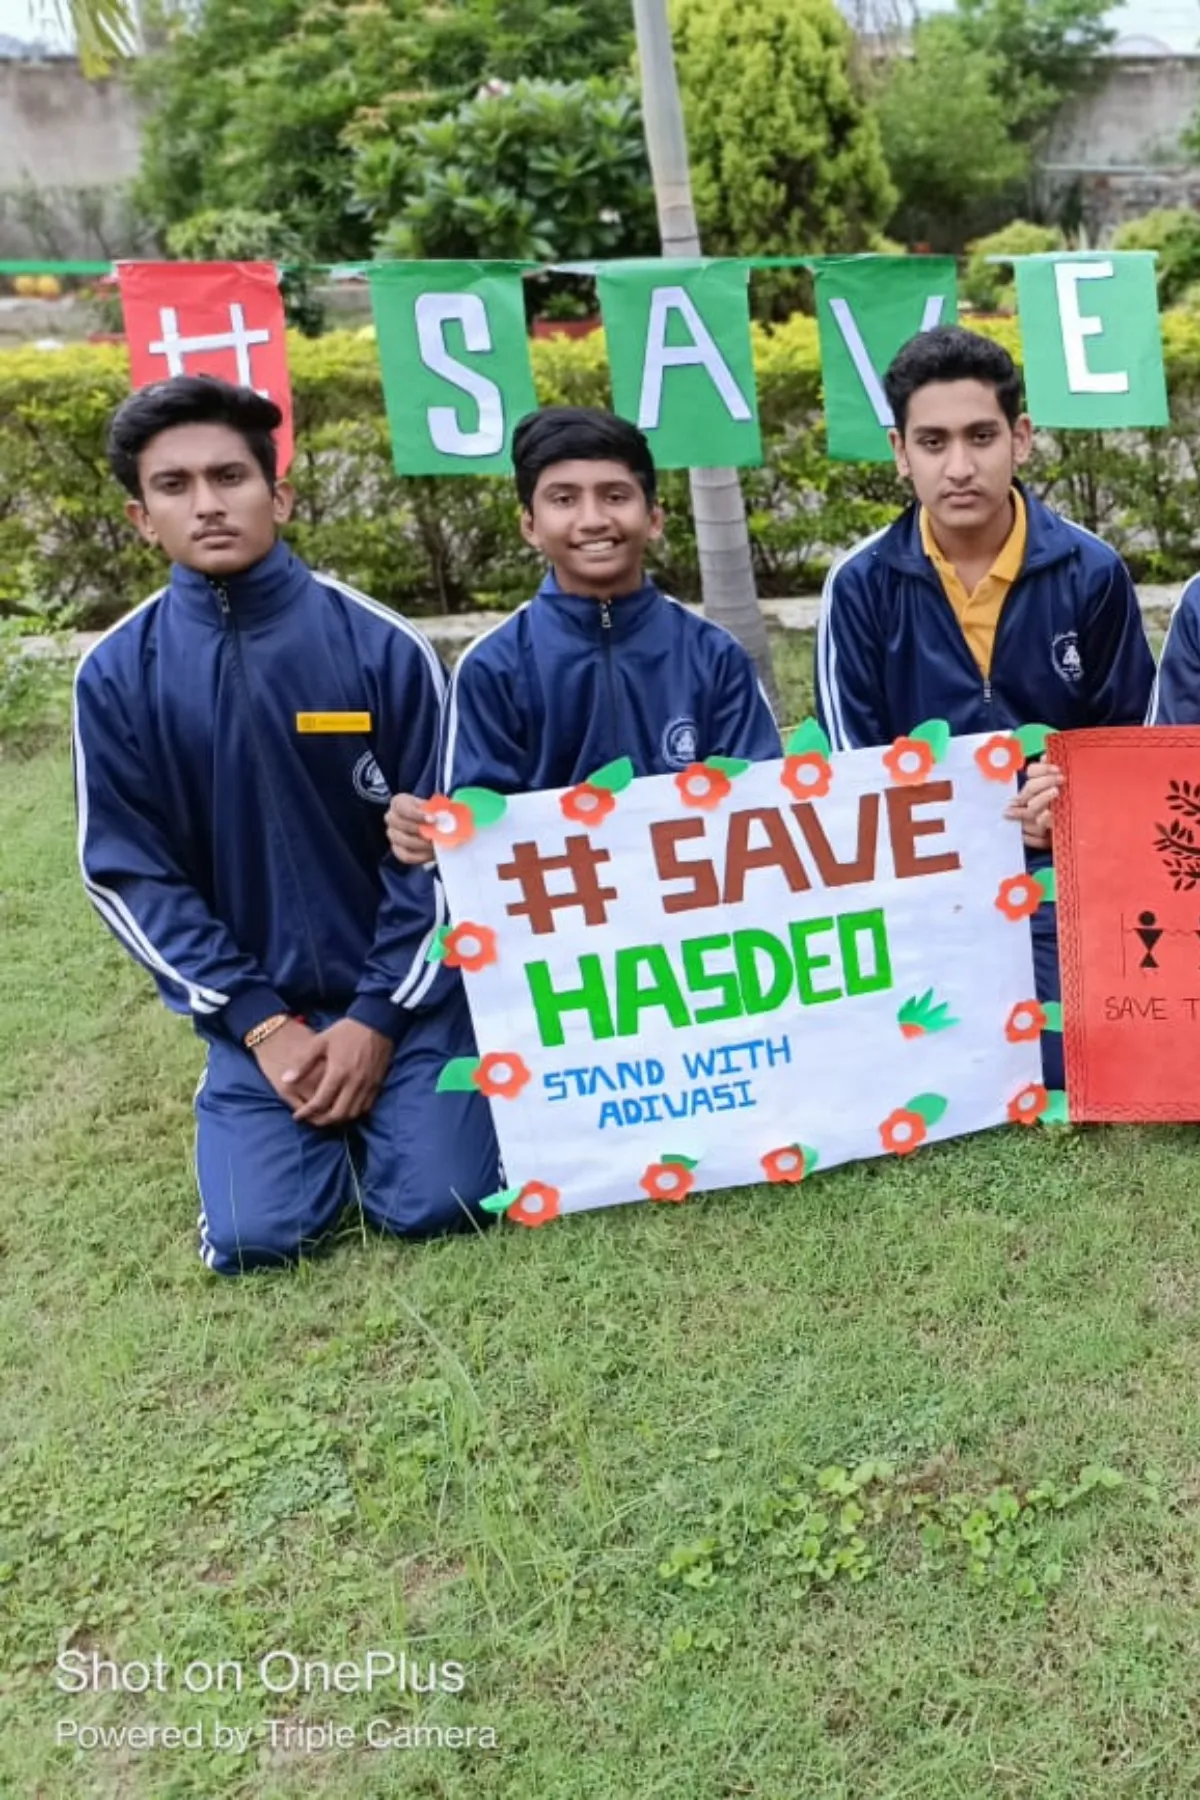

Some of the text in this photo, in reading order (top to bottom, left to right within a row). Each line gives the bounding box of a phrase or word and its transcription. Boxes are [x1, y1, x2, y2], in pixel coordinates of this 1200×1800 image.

[525, 907, 893, 1047] HASDEO
[1105, 996, 1168, 1022] SAVE
[543, 1034, 792, 1102] STAND WITH
[598, 1079, 758, 1130] ADIVASI
